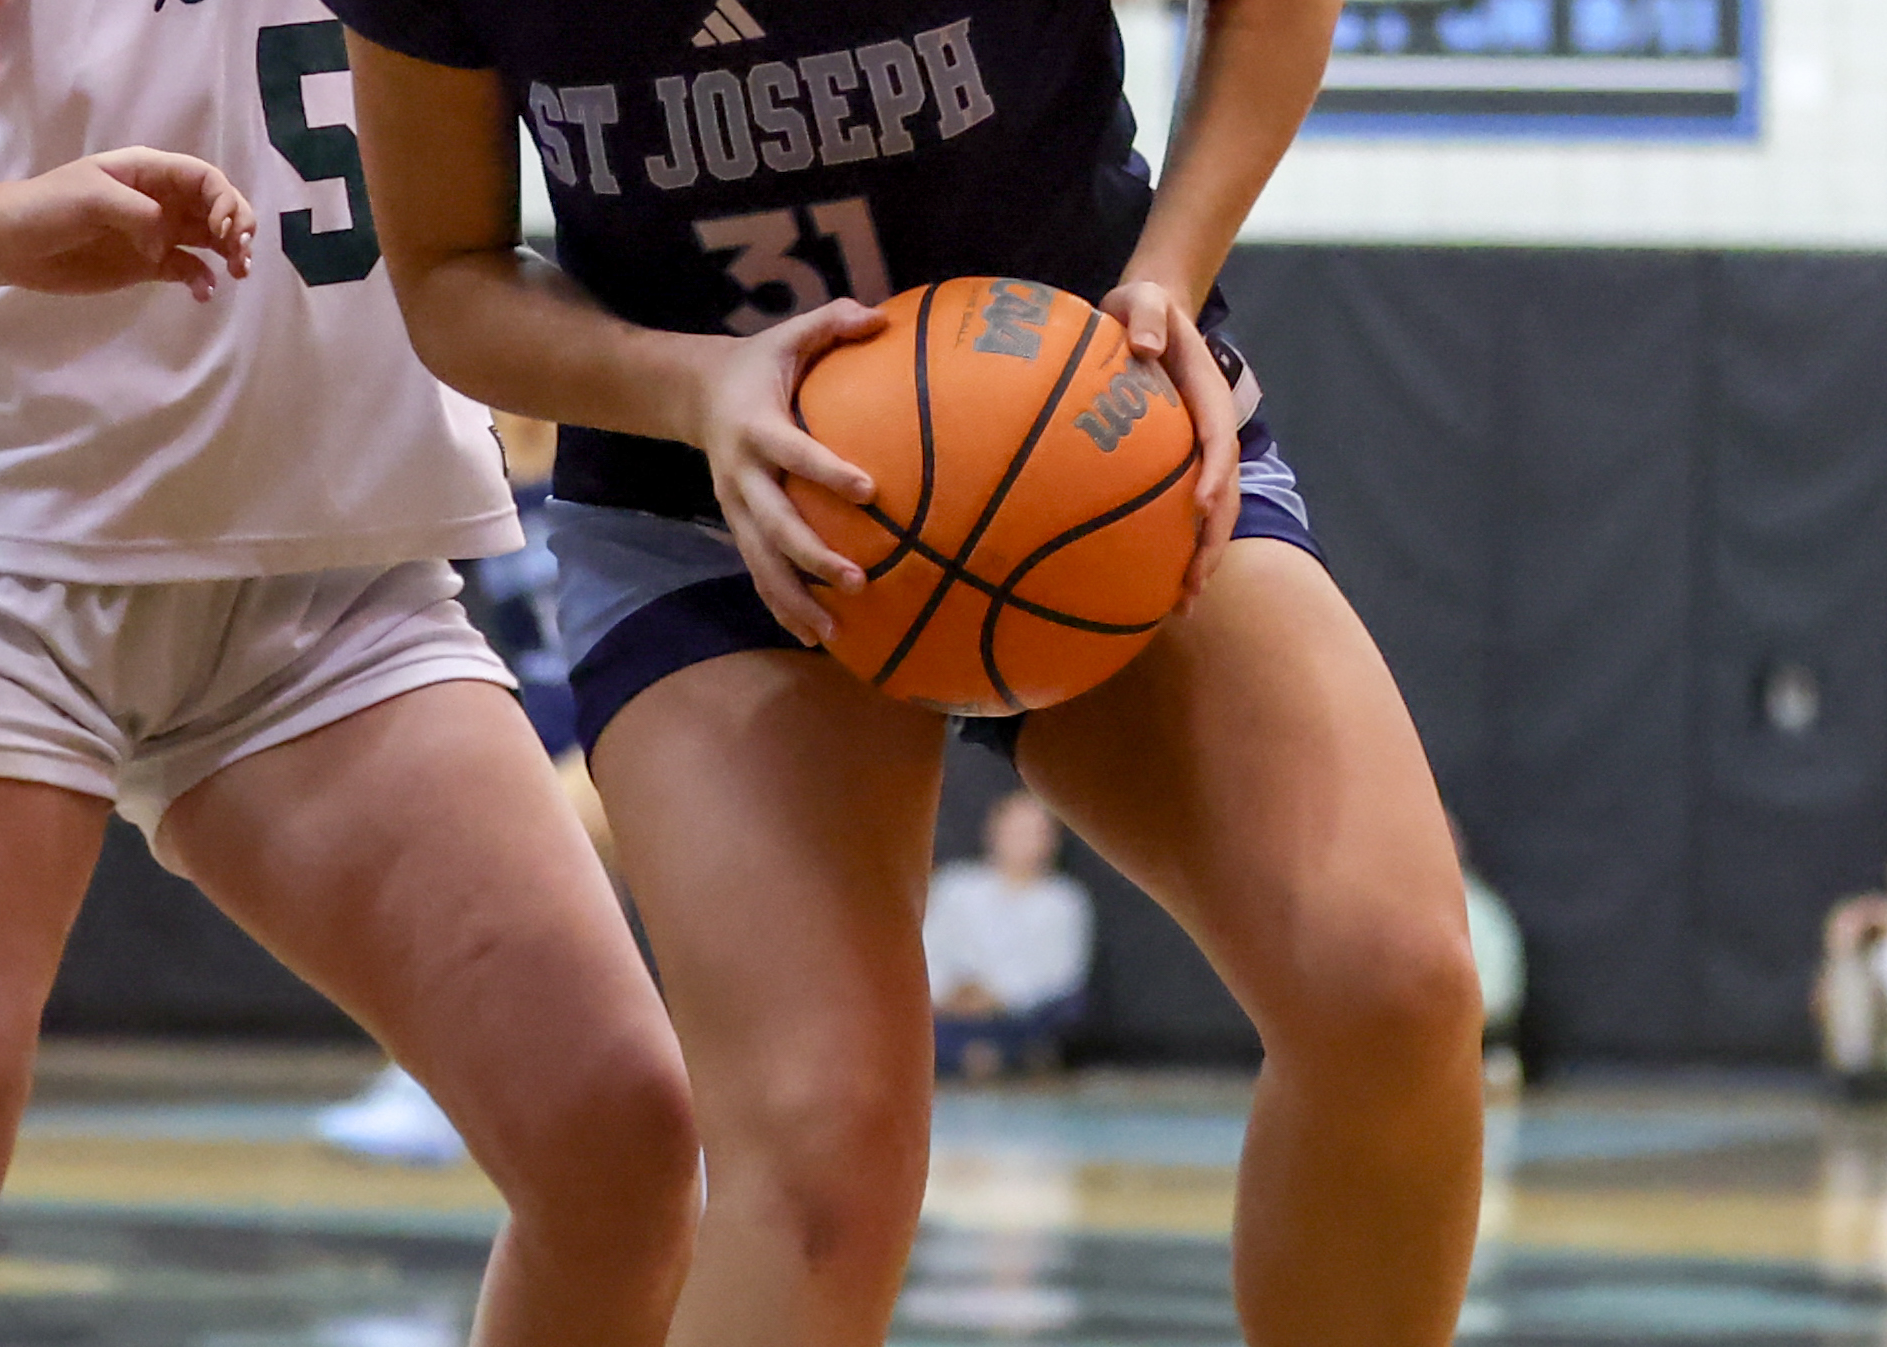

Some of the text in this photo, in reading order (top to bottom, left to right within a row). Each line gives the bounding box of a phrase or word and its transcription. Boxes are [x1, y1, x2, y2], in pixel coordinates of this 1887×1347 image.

[257, 19, 381, 287] 5
[528, 18, 994, 194] ST JOSEPH
[691, 197, 894, 337] 31
